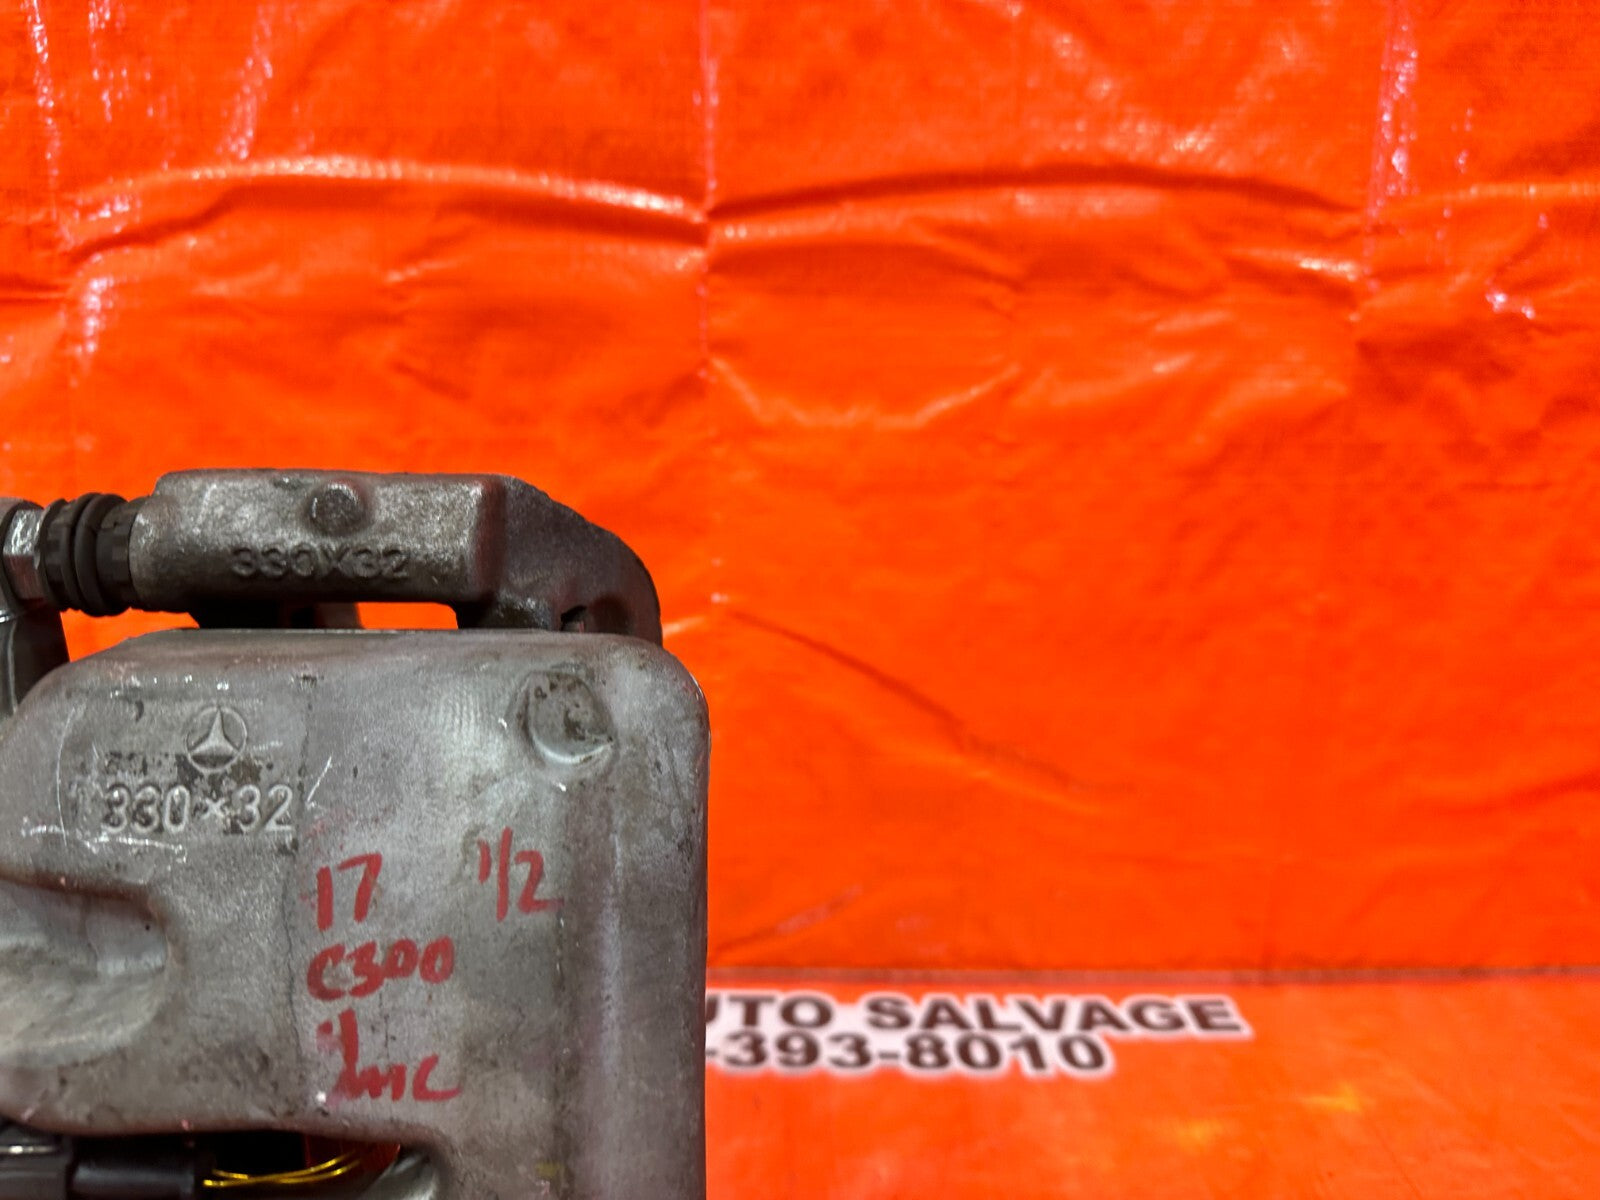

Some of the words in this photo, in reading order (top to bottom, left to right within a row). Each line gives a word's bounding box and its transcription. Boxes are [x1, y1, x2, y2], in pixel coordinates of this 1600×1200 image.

[314, 853, 382, 932] 17
[477, 827, 564, 922] 1/2
[307, 936, 455, 1000] C300
[867, 994, 1240, 1033] SALVAGE
